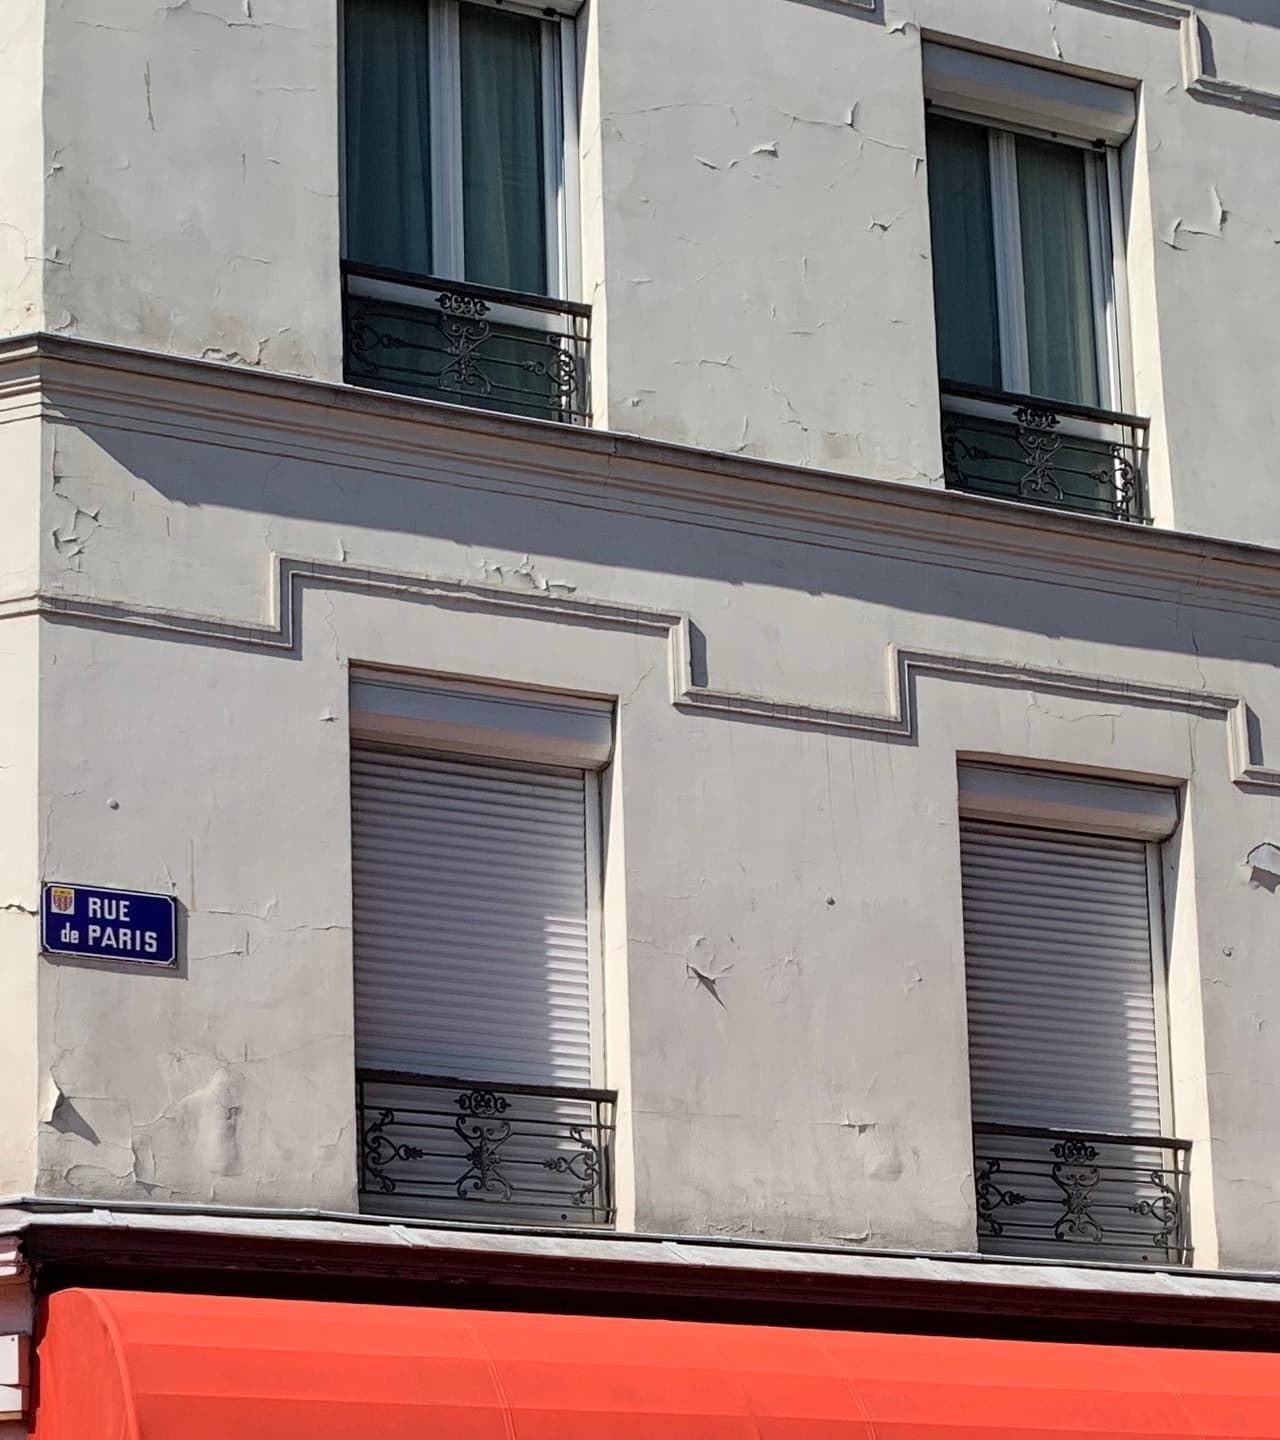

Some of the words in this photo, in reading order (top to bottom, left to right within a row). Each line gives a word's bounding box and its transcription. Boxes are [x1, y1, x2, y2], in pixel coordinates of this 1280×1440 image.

[88, 897, 130, 921] RUE
[60, 922, 79, 944] de
[88, 925, 157, 953] PARIS
